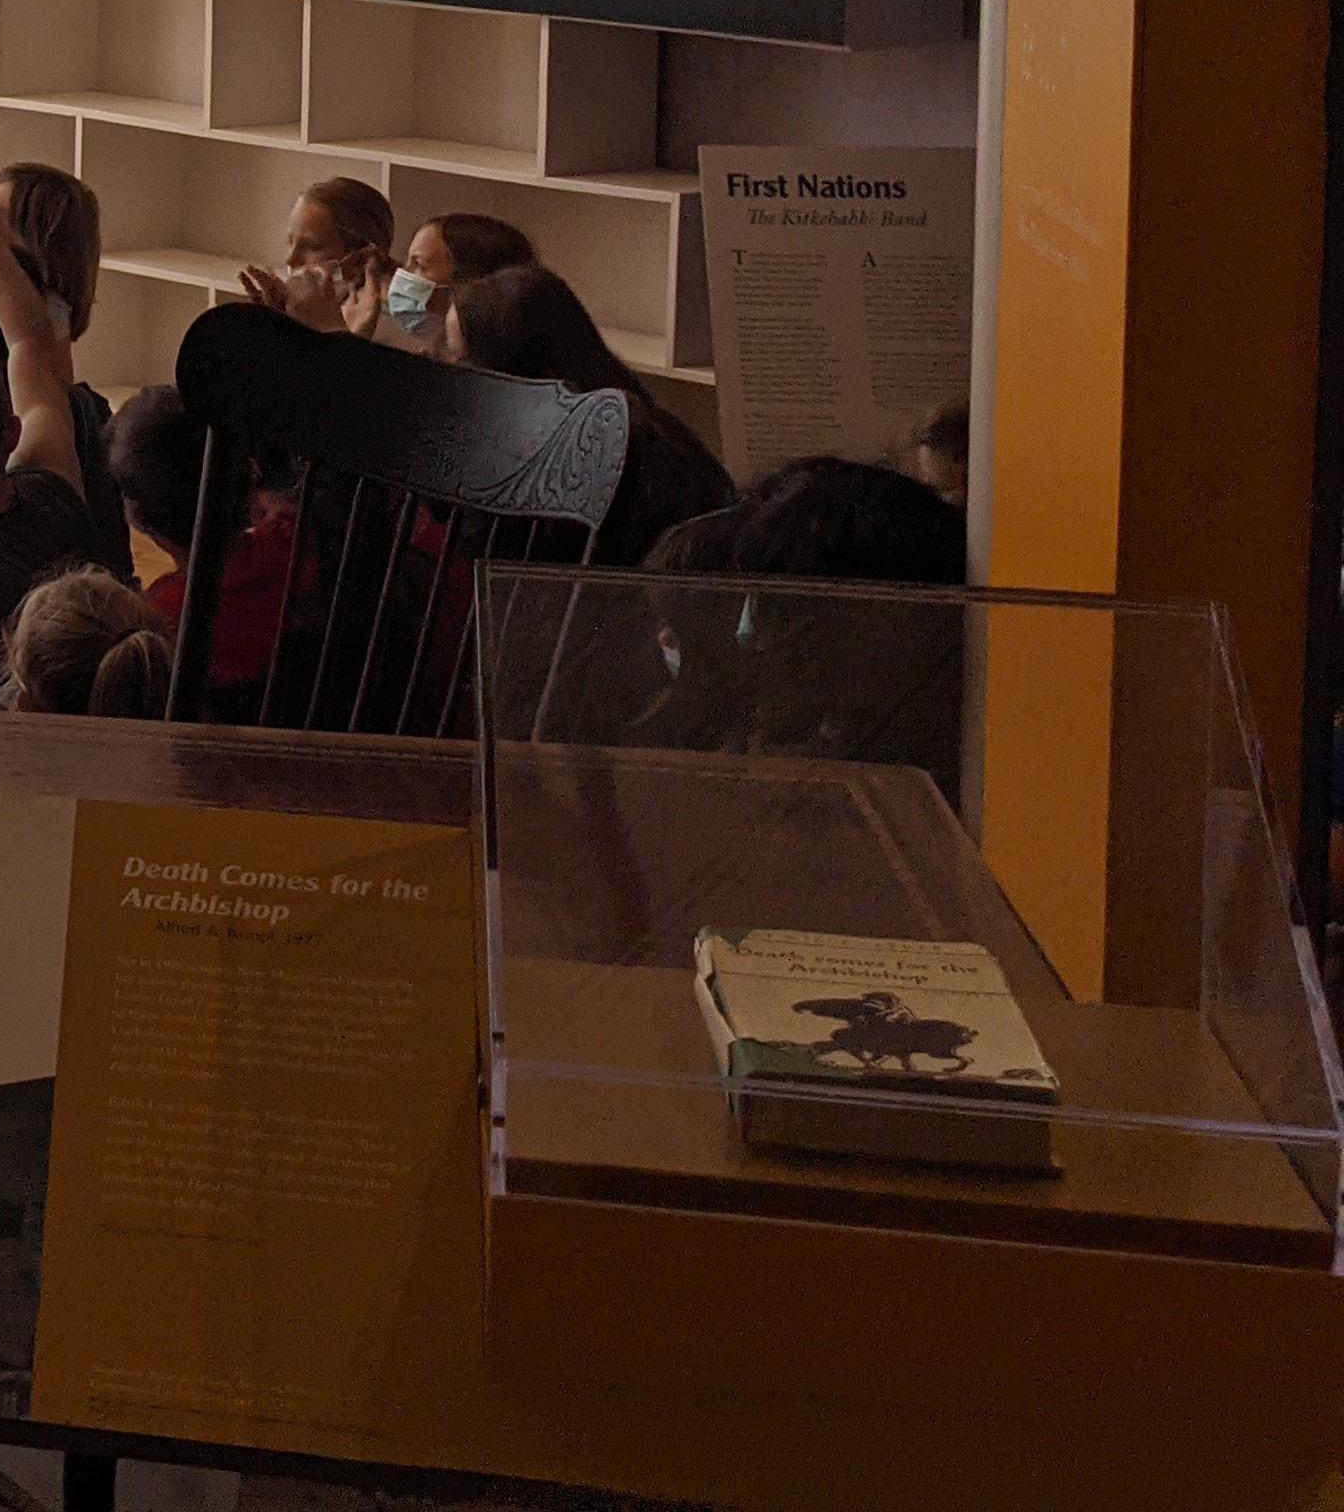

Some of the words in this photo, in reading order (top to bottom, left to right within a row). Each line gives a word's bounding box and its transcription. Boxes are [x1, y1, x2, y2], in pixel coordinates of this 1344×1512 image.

[726, 173, 787, 199] First
[798, 174, 906, 200] Nations
[122, 857, 209, 886] Death
[220, 863, 320, 893] Comes
[330, 873, 374, 899] for
[382, 877, 430, 903] the
[120, 888, 292, 927] Archbishop
